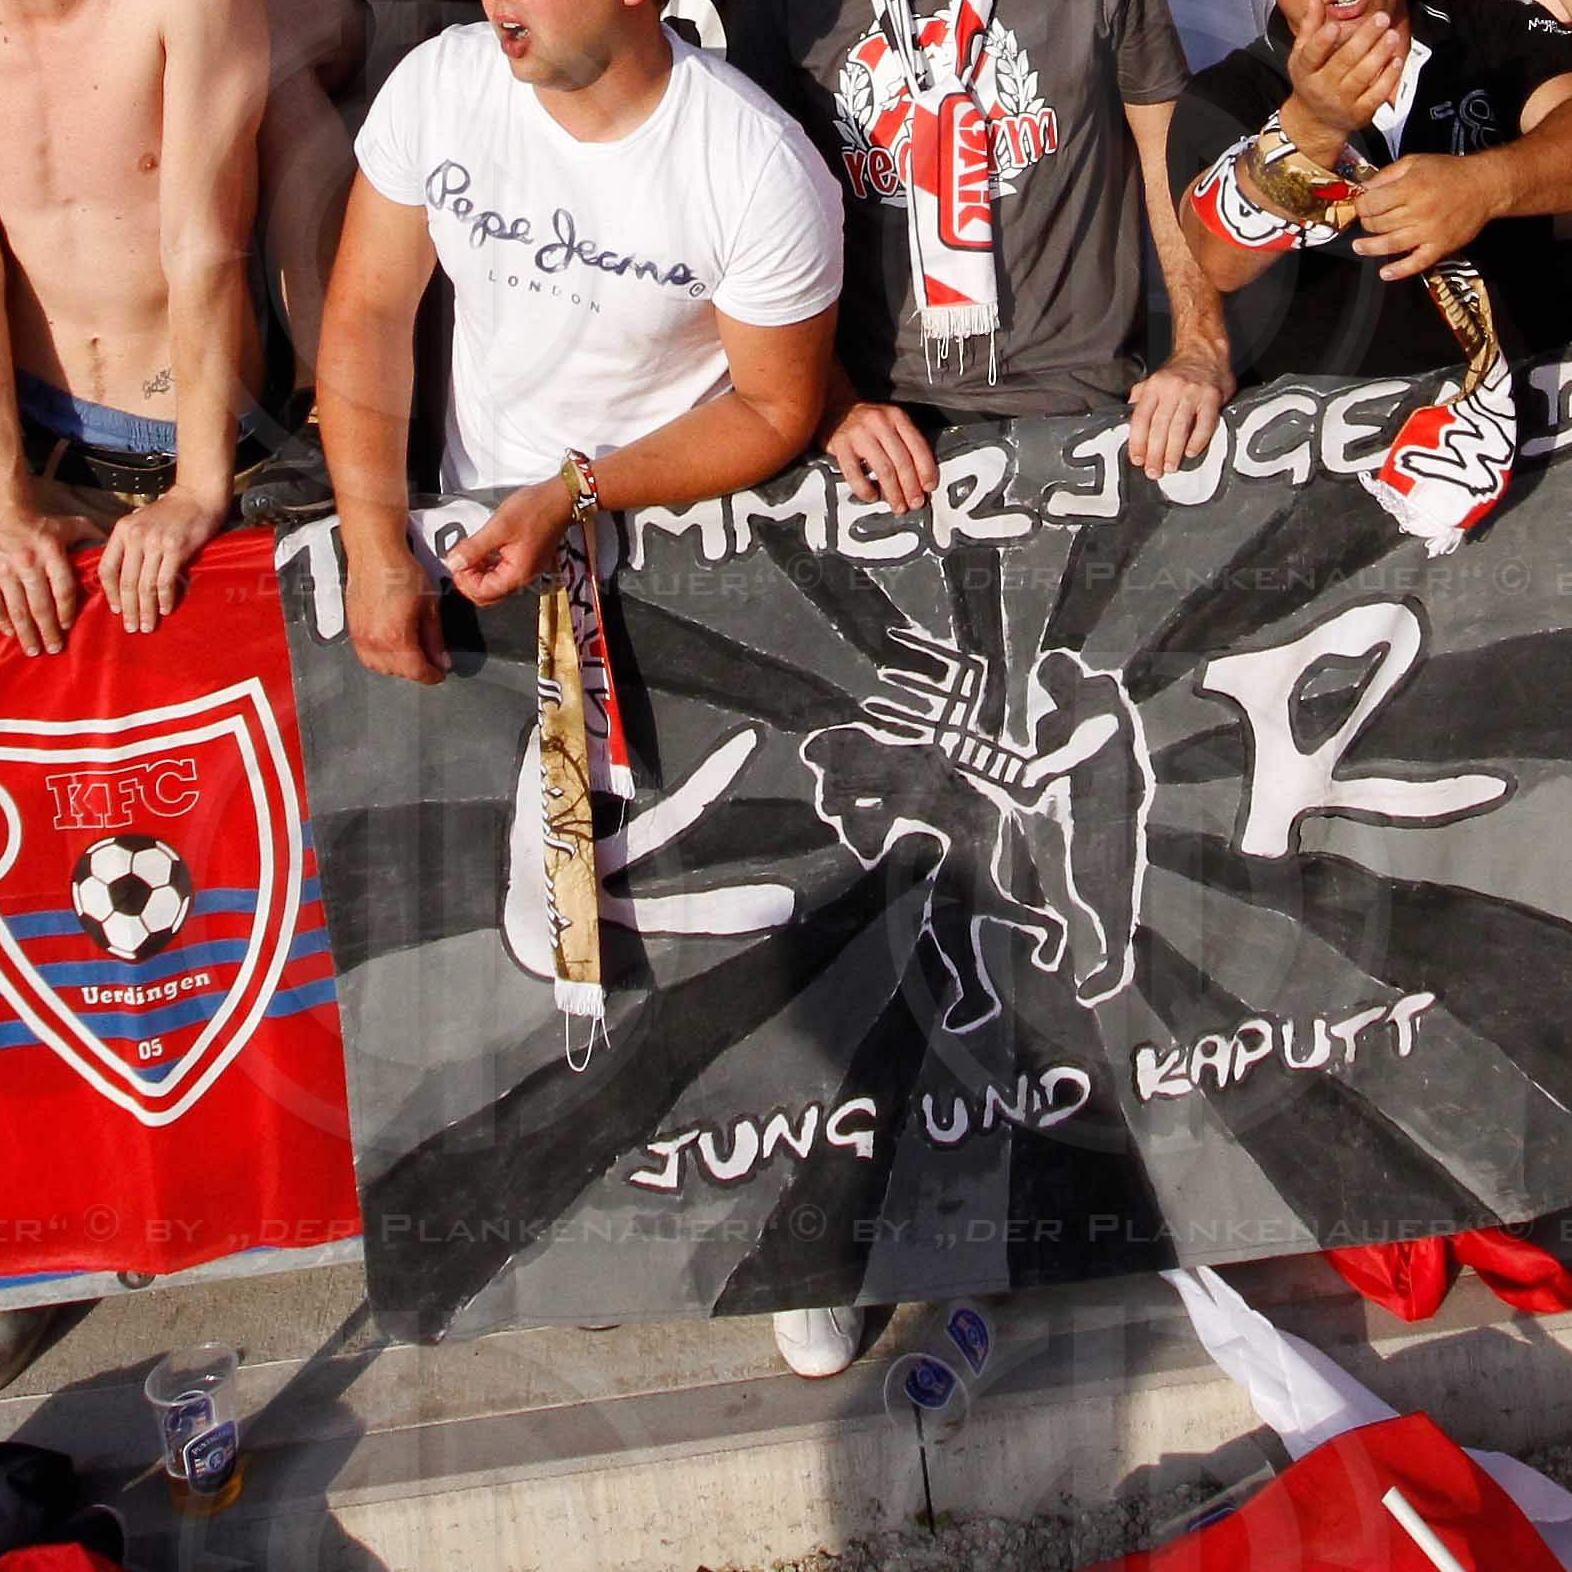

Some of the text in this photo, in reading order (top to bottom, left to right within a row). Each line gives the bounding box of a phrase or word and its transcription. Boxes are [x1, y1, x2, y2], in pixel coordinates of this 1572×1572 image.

[425, 159, 699, 285] Pepe Jeans
[45, 758, 200, 830] KFC
[81, 971, 212, 1006] Uerdingen
[138, 1037, 164, 1060] 05
[629, 990, 1436, 1192] JUNG UND KAPUTT
